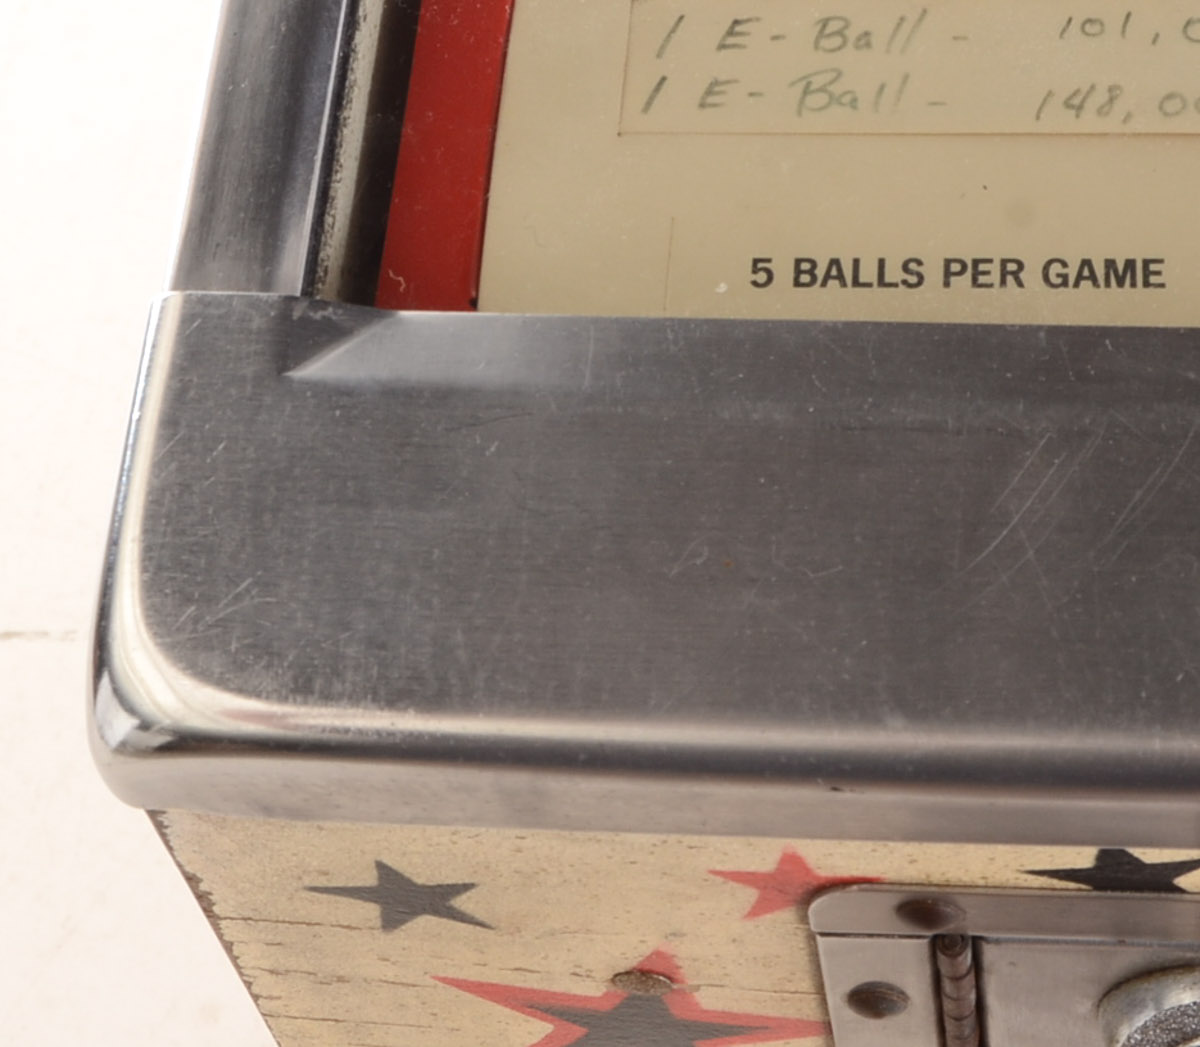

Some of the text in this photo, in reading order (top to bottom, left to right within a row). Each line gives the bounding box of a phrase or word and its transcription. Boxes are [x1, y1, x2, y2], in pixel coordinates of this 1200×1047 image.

[813, 8, 928, 54] Ball
[788, 68, 911, 118] Ball
[750, 257, 1166, 289] 5 BALLS PER GAME
